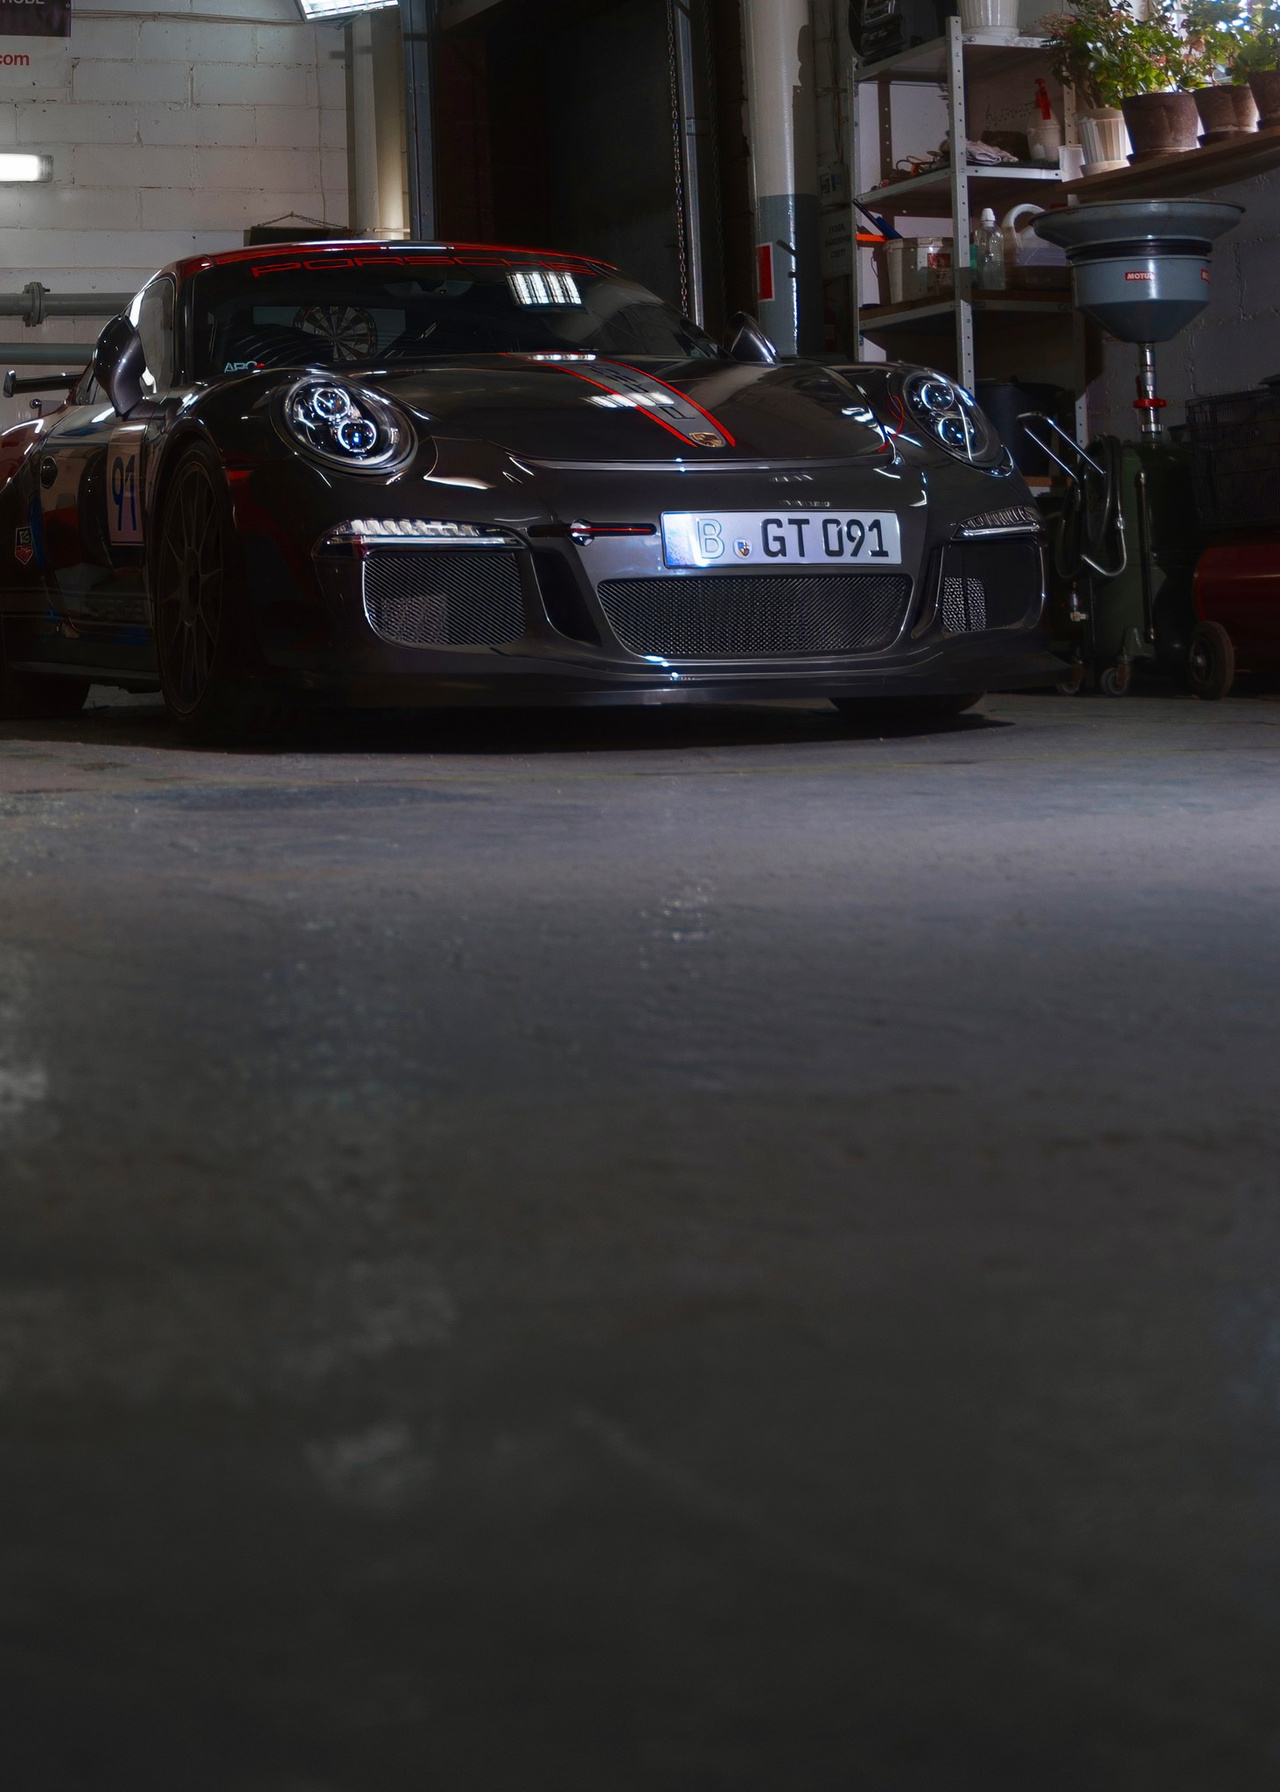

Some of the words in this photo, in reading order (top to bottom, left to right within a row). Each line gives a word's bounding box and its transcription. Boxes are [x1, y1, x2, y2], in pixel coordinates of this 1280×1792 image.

[111, 455, 137, 531] 91
[696, 518, 725, 559] B
[761, 518, 810, 558] GT
[821, 518, 890, 558] 091
